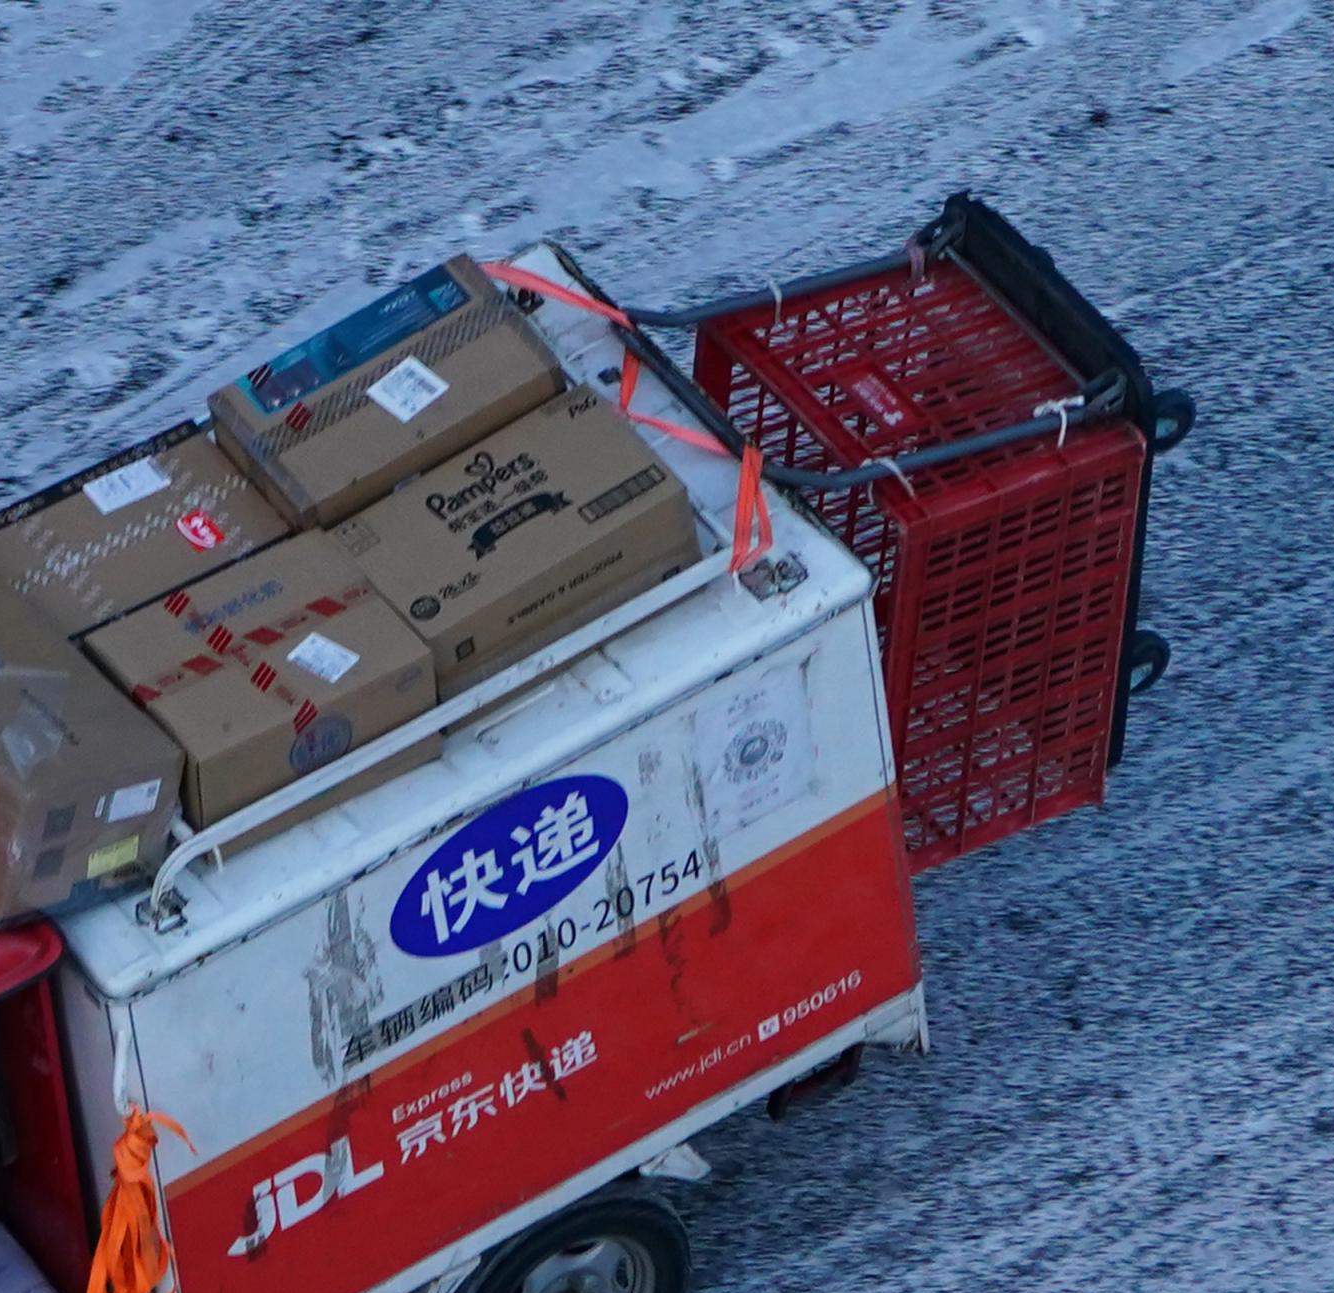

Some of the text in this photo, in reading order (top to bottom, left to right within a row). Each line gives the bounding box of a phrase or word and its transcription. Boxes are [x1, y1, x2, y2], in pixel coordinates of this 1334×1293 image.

[425, 452, 538, 521] Pampers
[420, 790, 600, 944] 快递
[782, 968, 863, 1027] 950616
[391, 1072, 473, 1125] Express
[396, 1030, 598, 1165] 京东快递
[644, 1034, 752, 1101] www.jdl.cn
[227, 1136, 385, 1257] JDL
